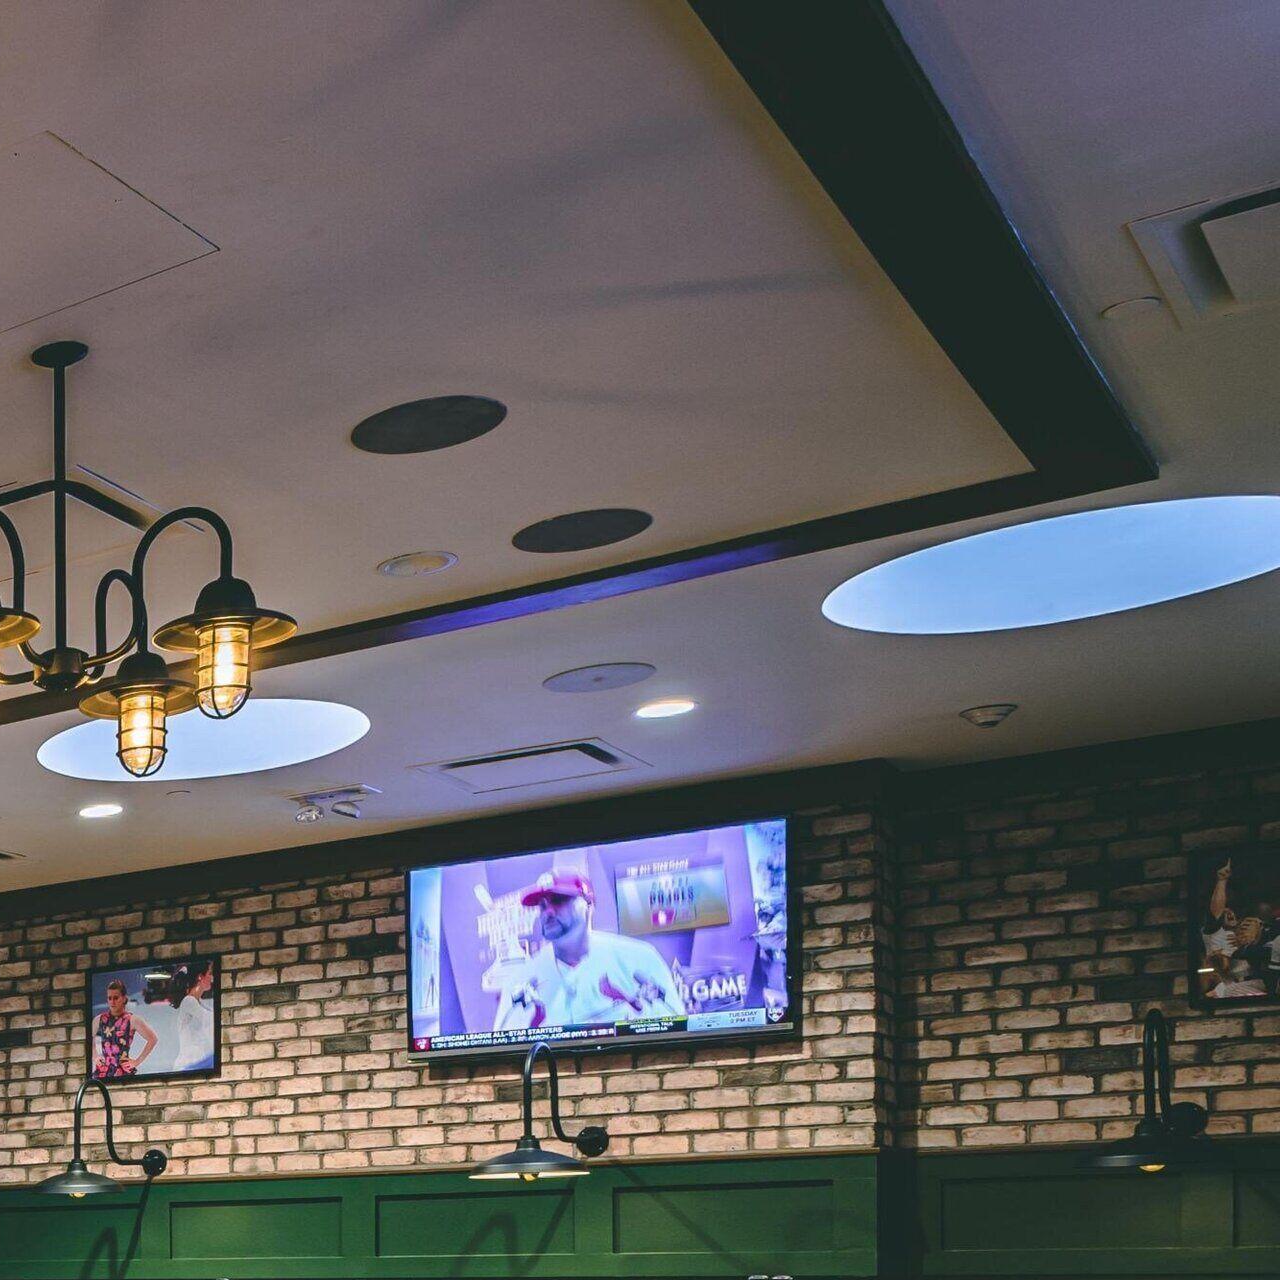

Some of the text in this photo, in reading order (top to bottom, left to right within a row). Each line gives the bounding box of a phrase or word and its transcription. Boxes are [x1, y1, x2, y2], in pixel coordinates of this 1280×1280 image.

[692, 974, 747, 1002] GAME
[729, 1010, 758, 1018] TUESDAY
[431, 1027, 563, 1043] AMERICAN LEAGUE ALL-STAR STARTERS
